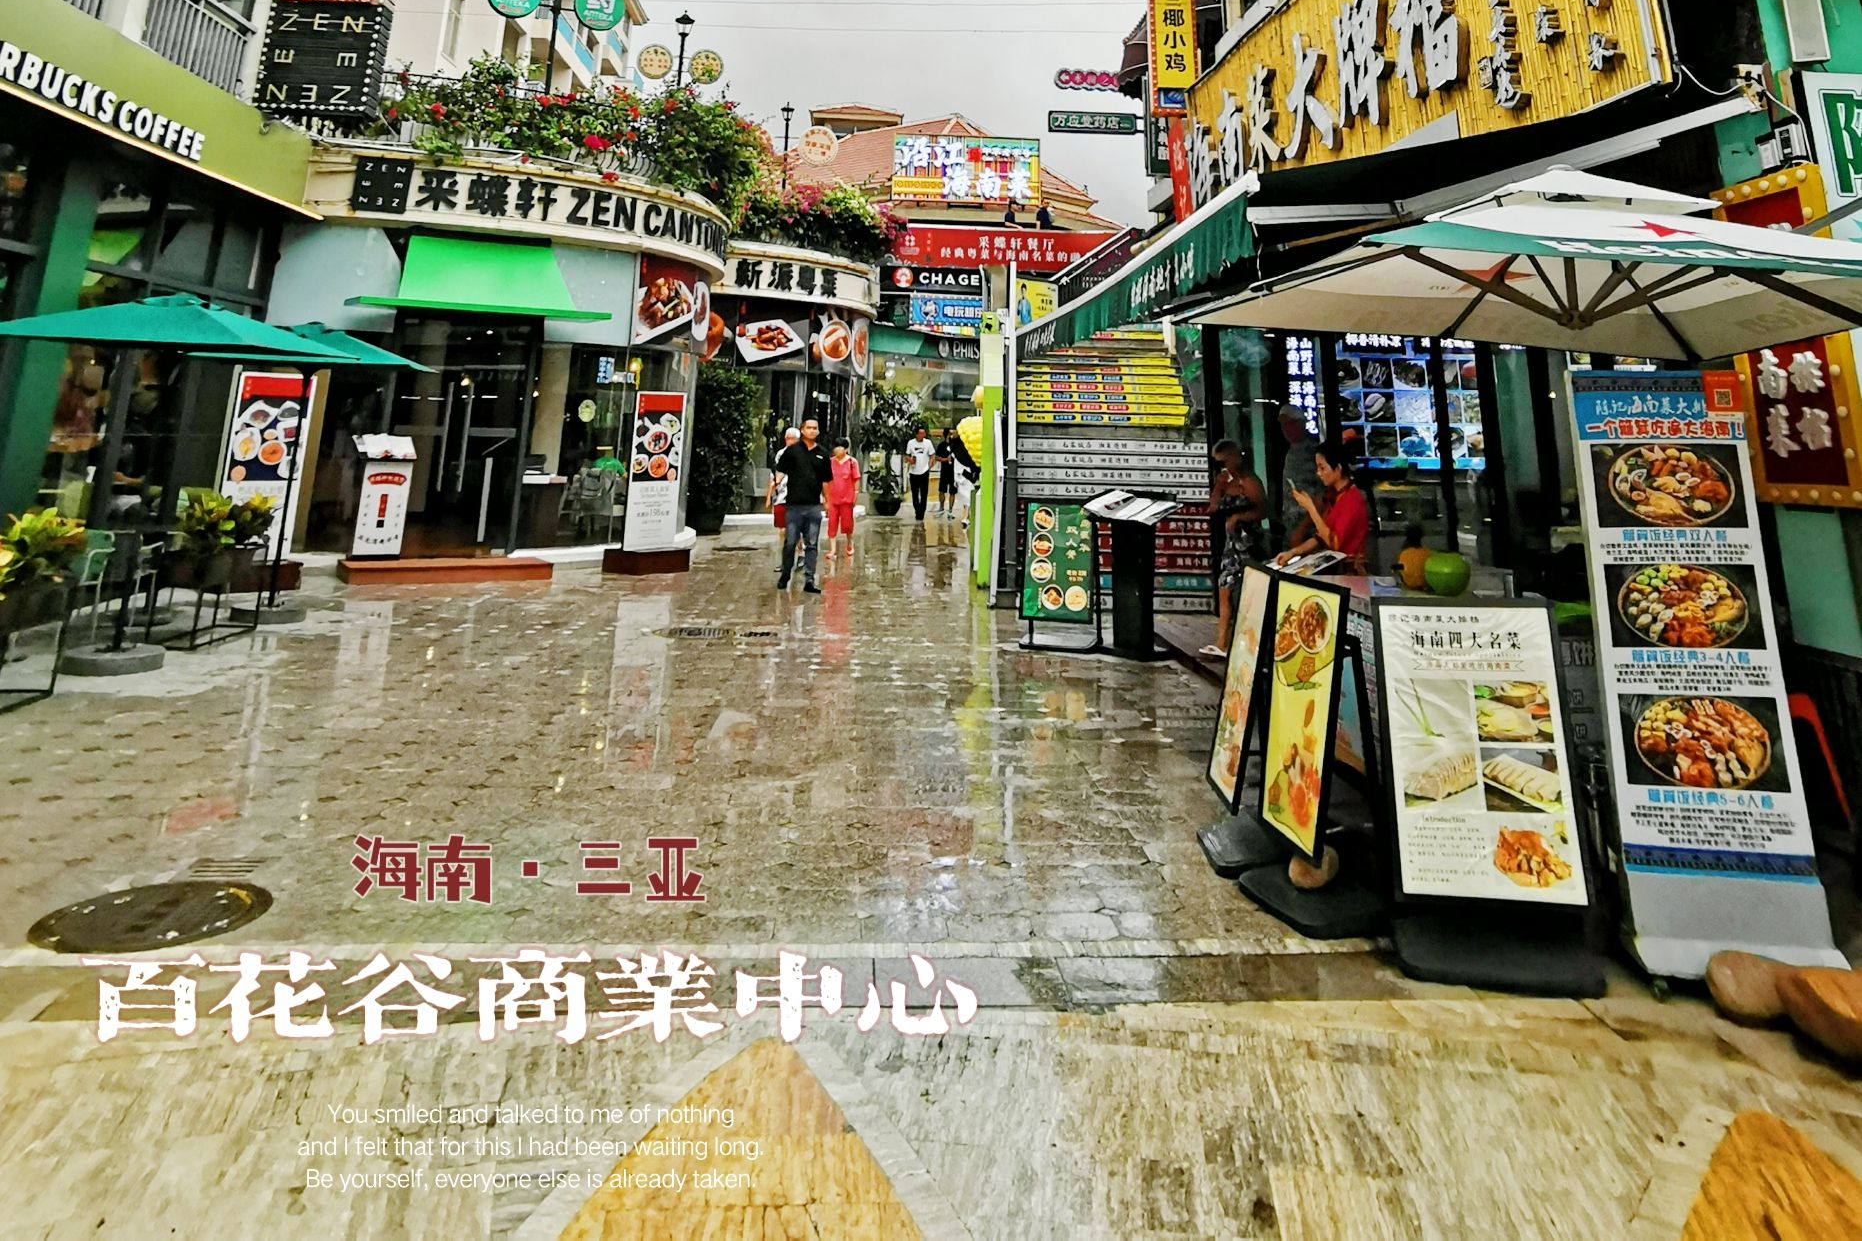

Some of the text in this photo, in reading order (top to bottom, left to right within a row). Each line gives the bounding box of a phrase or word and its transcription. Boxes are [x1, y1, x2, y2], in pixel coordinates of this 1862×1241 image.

[279, 13, 364, 33] ZEN
[1163, 9, 1187, 72] 椰小鸡
[118, 100, 205, 161] COFFEE
[416, 170, 557, 221] 采蝶轩
[566, 188, 638, 232] ZEN
[943, 166, 1032, 200] 海南菜
[1410, 630, 1522, 651] 海南四大名菜
